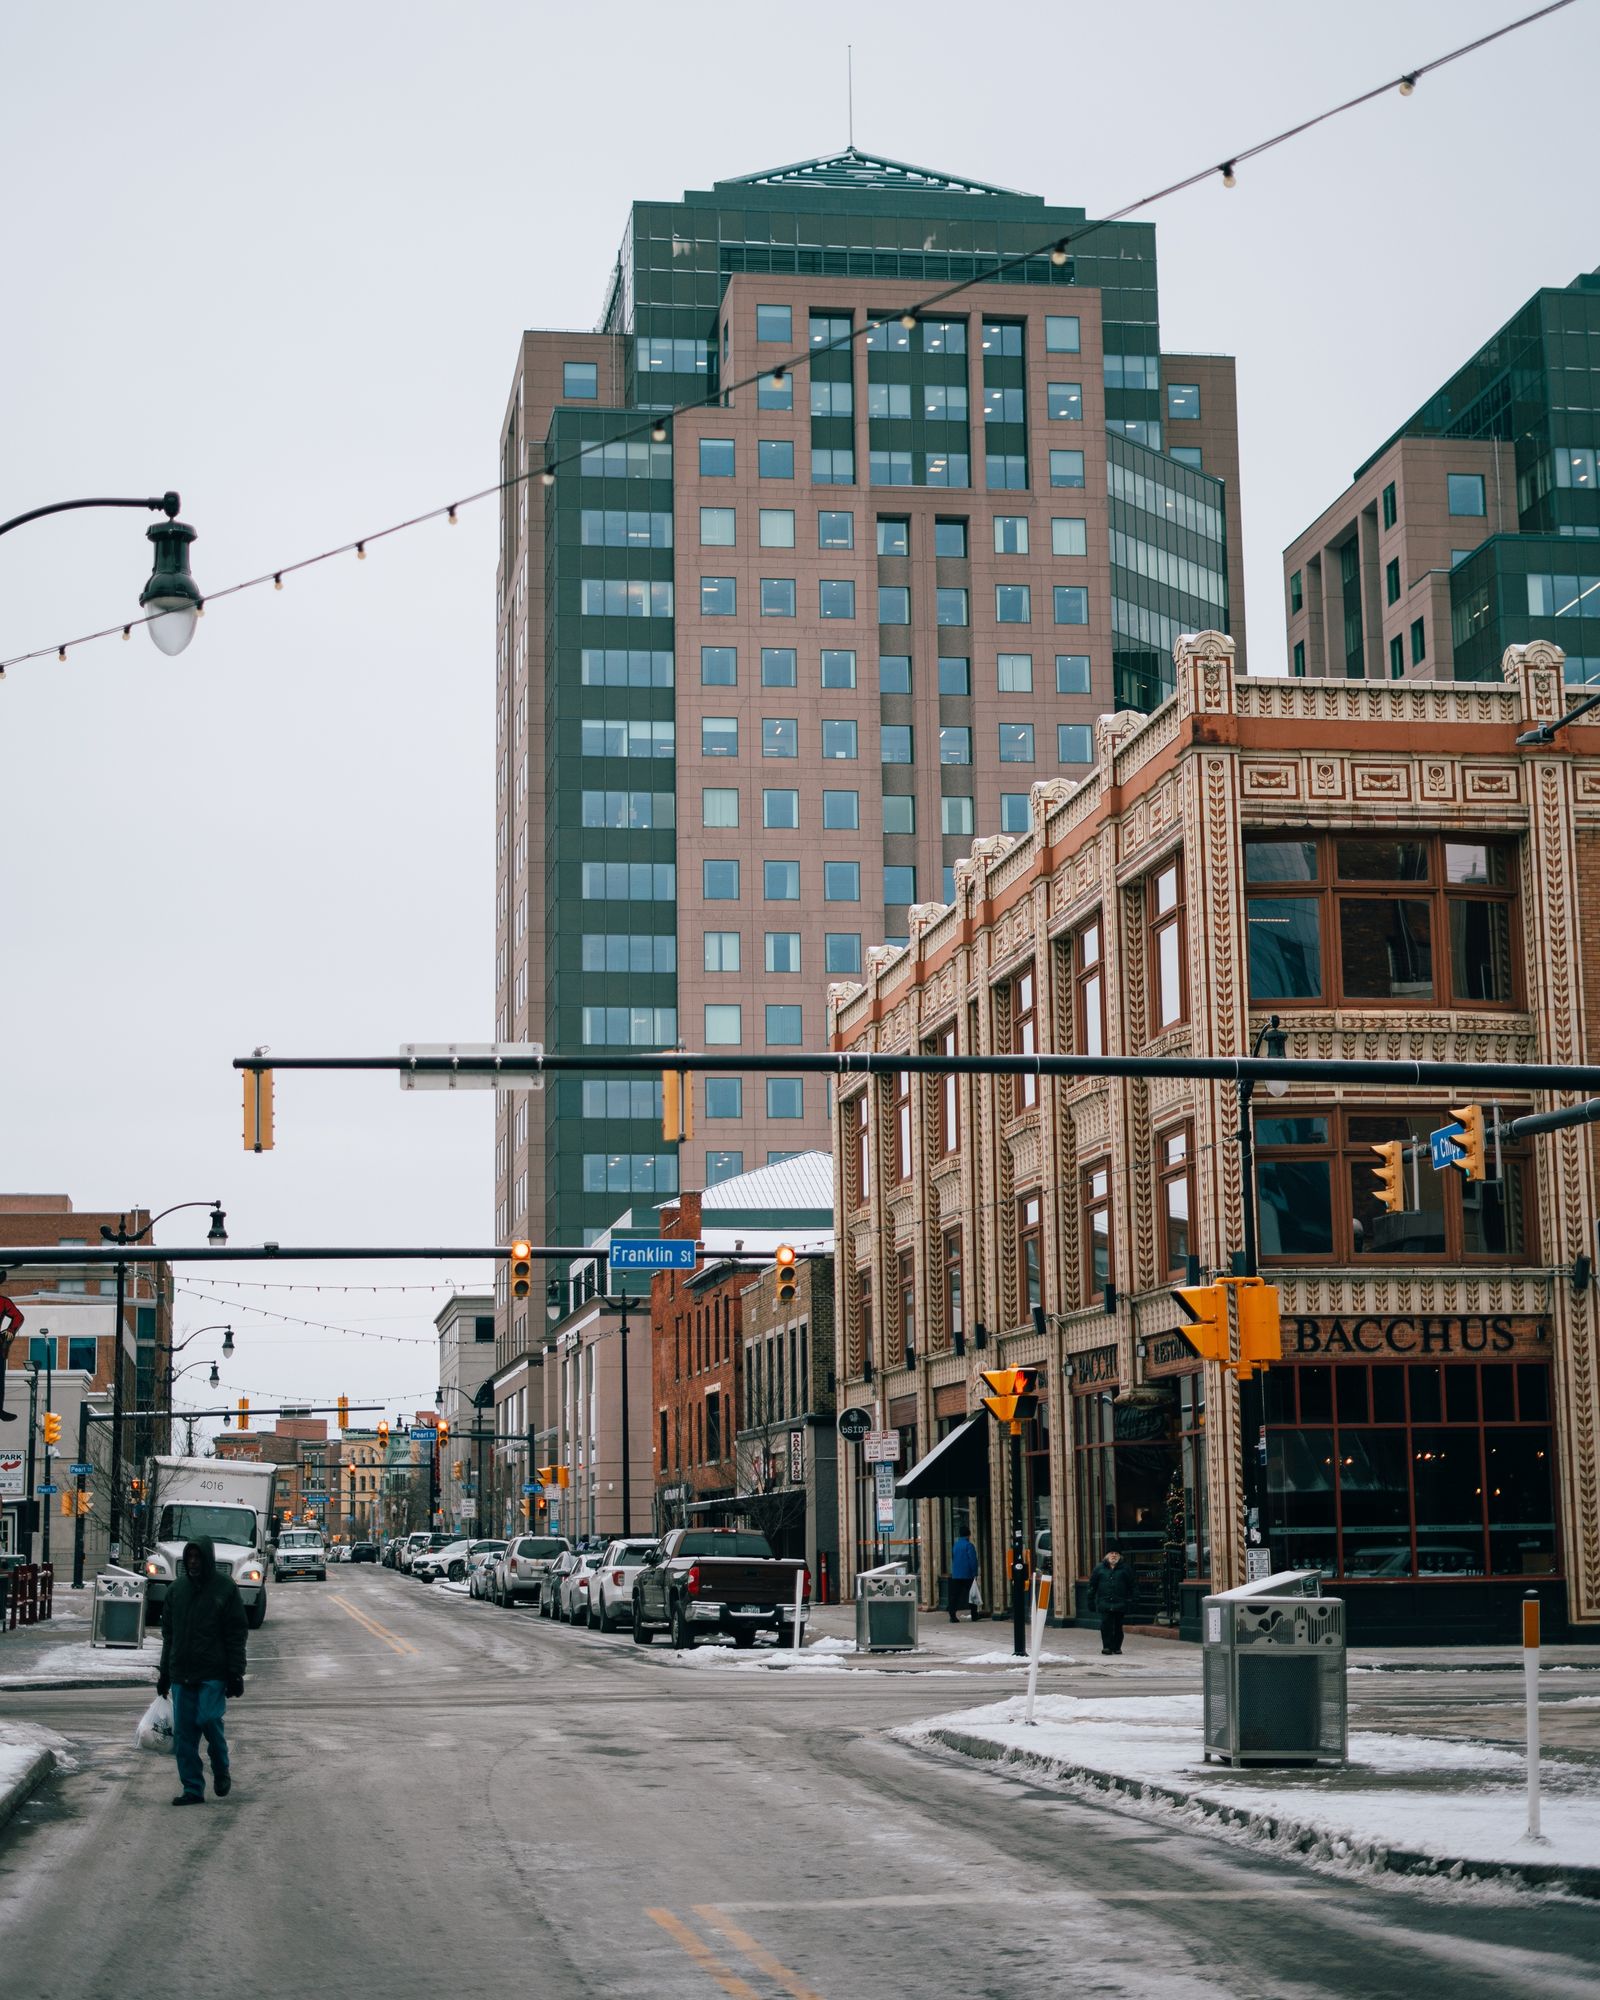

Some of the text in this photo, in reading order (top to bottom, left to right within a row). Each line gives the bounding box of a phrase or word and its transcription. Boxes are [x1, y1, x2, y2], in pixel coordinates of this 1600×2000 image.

[1440, 1137, 1461, 1160] Chipp
[612, 1245, 692, 1262] Franklin St
[1294, 1317, 1515, 1353] BACCHUS
[1154, 1338, 1191, 1364] RESTAU
[412, 1431, 428, 1439] Pearl
[200, 1480, 224, 1491] 4016
